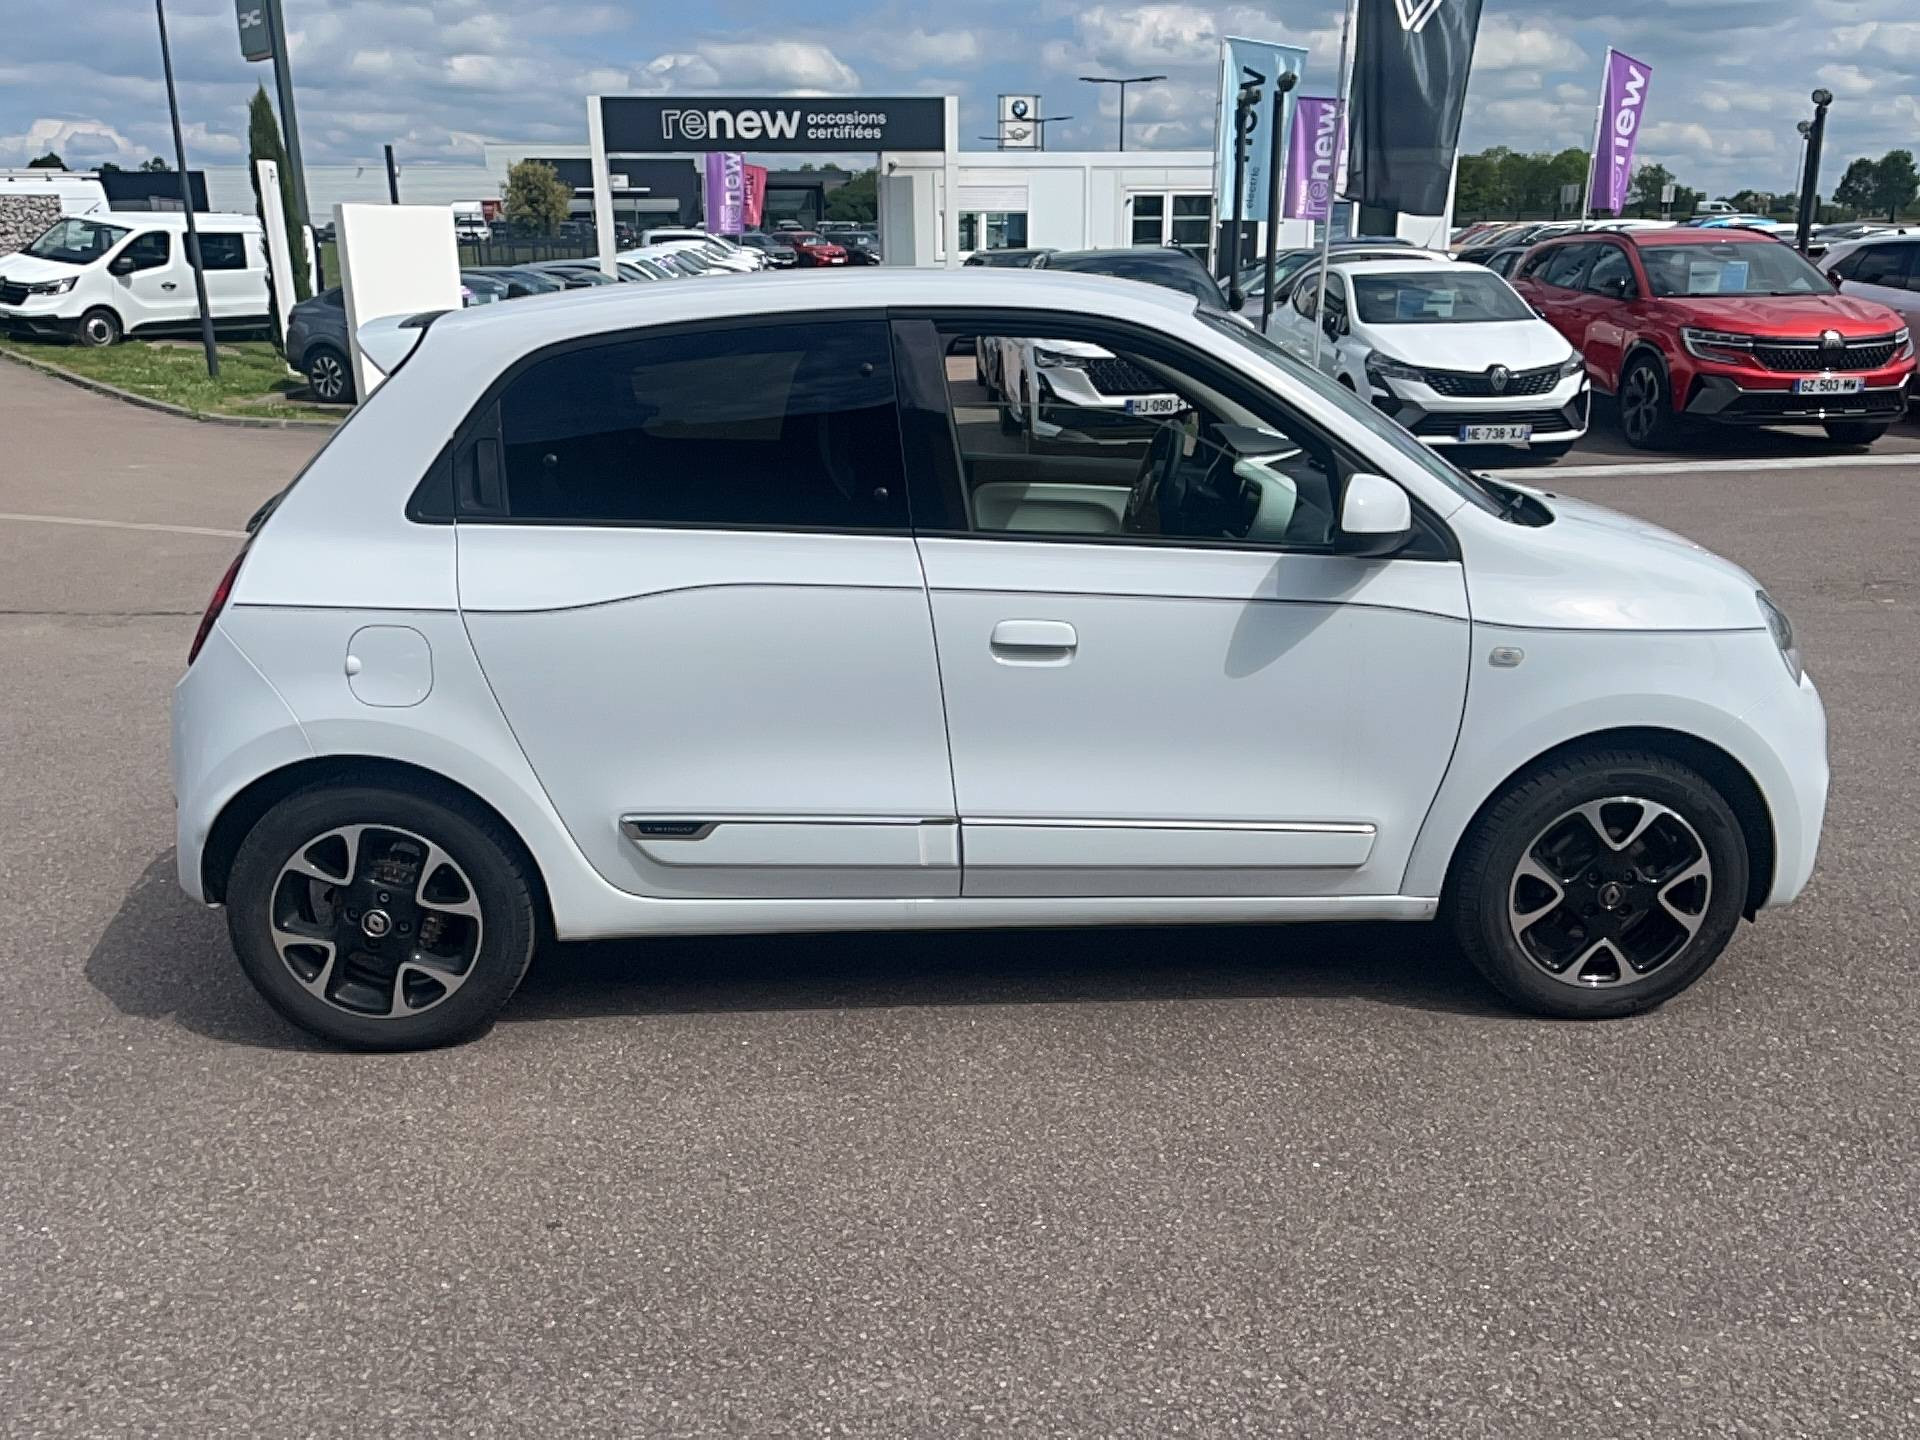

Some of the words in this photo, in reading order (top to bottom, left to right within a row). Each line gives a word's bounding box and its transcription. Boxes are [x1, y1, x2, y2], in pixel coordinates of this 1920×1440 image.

[661, 109, 801, 140] renew
[807, 111, 887, 126] occasions
[807, 125, 882, 139] certifiées
[1305, 102, 1337, 215] renew
